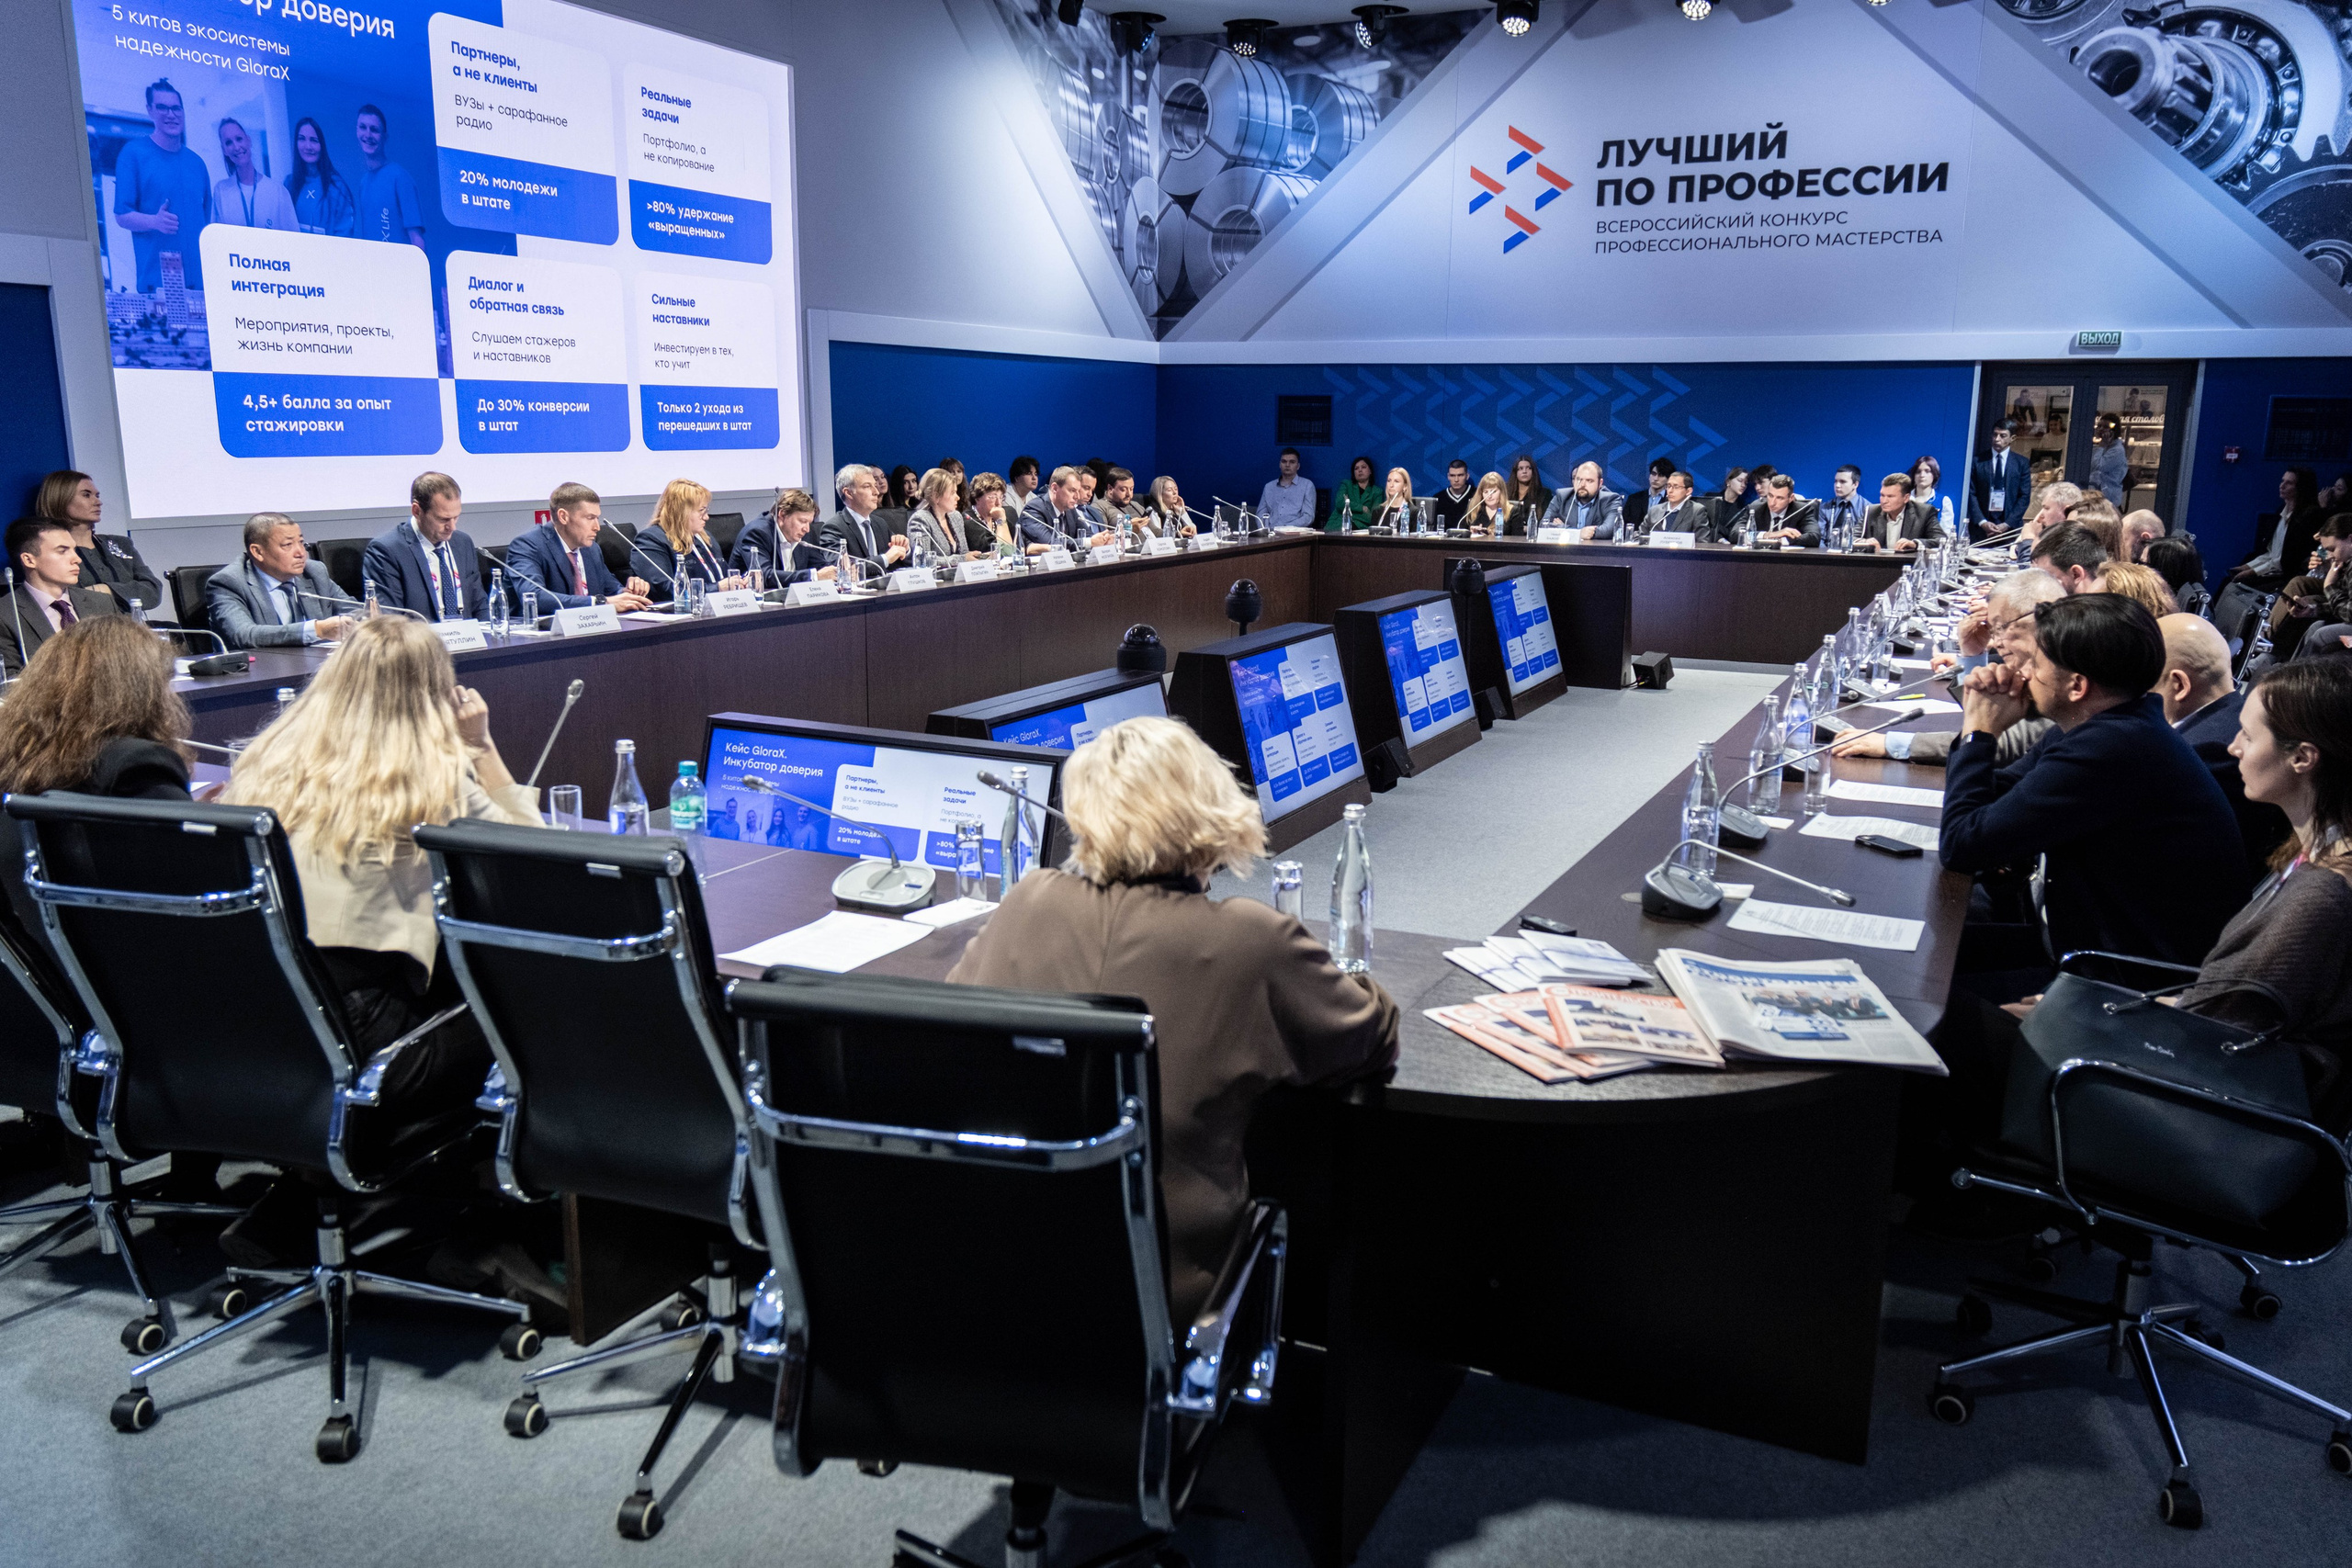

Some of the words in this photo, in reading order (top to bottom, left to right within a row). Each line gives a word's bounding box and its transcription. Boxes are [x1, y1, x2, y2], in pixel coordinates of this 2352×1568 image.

[281, 0, 396, 39] доверия
[112, 5, 123, 21] 5
[130, 8, 181, 33] китов
[187, 23, 290, 56] экосистемы
[115, 34, 232, 70] надежности
[236, 58, 291, 81] GloraX
[451, 41, 521, 71] Партнеры,
[453, 65, 461, 77] а
[465, 68, 481, 81] не
[484, 72, 537, 93] клиенты
[641, 86, 692, 108] Реальные
[455, 95, 485, 111] ВУЗы
[498, 105, 568, 128] сарафанное
[641, 107, 680, 125] задачи
[456, 115, 493, 131] радио
[643, 133, 699, 155] Портфолио,
[700, 147, 707, 155] а
[1596, 121, 1789, 169] ЛУЧШИЙ
[643, 152, 655, 162] не
[657, 154, 715, 173] копирование
[459, 170, 489, 186] 20%
[492, 177, 559, 197] молодежи
[1596, 177, 1655, 207] ПО
[1668, 162, 1950, 204] ПРОФЕССИИ
[461, 194, 469, 205] в
[472, 196, 511, 209] штате
[647, 201, 675, 215] >80%
[678, 206, 734, 224] удержание
[1596, 211, 1754, 233] ВСЕРОССИЙСКИЙ
[1760, 210, 1849, 226] КОНКУРС
[649, 220, 726, 240] «выращенных»
[1595, 231, 1810, 254] ПРОФЕССИОНАЛЬНОГО
[1815, 229, 1943, 247] МАСТЕРСТВА
[229, 253, 291, 272] Полная
[232, 279, 325, 299] интеграция
[469, 276, 514, 292] Диалог
[517, 283, 525, 293] и
[469, 298, 528, 314] обратная
[532, 305, 564, 316] связь
[651, 294, 695, 308] Сильные
[235, 317, 333, 335] Мероприятия,
[336, 324, 394, 339] проекты,
[652, 314, 710, 327] наставники
[472, 332, 522, 345] Слушаем
[526, 335, 576, 349] стажеров
[2081, 333, 2120, 344] ВЫХОД
[238, 340, 283, 352] жизнь
[287, 343, 353, 355] компании
[653, 343, 710, 356] Инвестируем
[718, 346, 734, 357] тех,
[473, 351, 481, 360] и
[482, 351, 551, 364] наставников
[655, 359, 670, 368] кто
[672, 359, 690, 371] учит
[243, 395, 277, 411] 4,5+
[282, 394, 331, 409] балла
[334, 399, 353, 410] за
[356, 399, 391, 411] опыт
[477, 399, 495, 413] До
[498, 400, 525, 412] 30%
[528, 401, 590, 413] конверсии
[657, 401, 692, 413] Только
[695, 402, 701, 413] 2
[703, 404, 730, 416] ухода
[733, 404, 743, 413] из
[245, 419, 345, 434] стажировки
[479, 422, 485, 431] в
[489, 421, 518, 432] штат
[2132, 414, 2165, 423] столов
[658, 421, 720, 434] перешедших
[723, 422, 729, 431] в
[730, 421, 752, 432] штат
[445, 637, 476, 645] ЯТУЛЛИН
[725, 742, 750, 754] Кейс
[752, 746, 787, 759] GloraX.
[723, 756, 777, 773] Инкубатор
[779, 764, 823, 778] доверия
[846, 774, 878, 785] Партнеры,
[859, 785, 886, 794] клиенты
[944, 787, 976, 796] Реальные
[842, 804, 859, 812] радио
[863, 799, 899, 808] сарафанное
[943, 796, 967, 805] задачи
[941, 809, 976, 819] Портфолио,
[838, 827, 852, 835] 20%
[842, 837, 861, 845] штате
[936, 840, 955, 849] >80%
